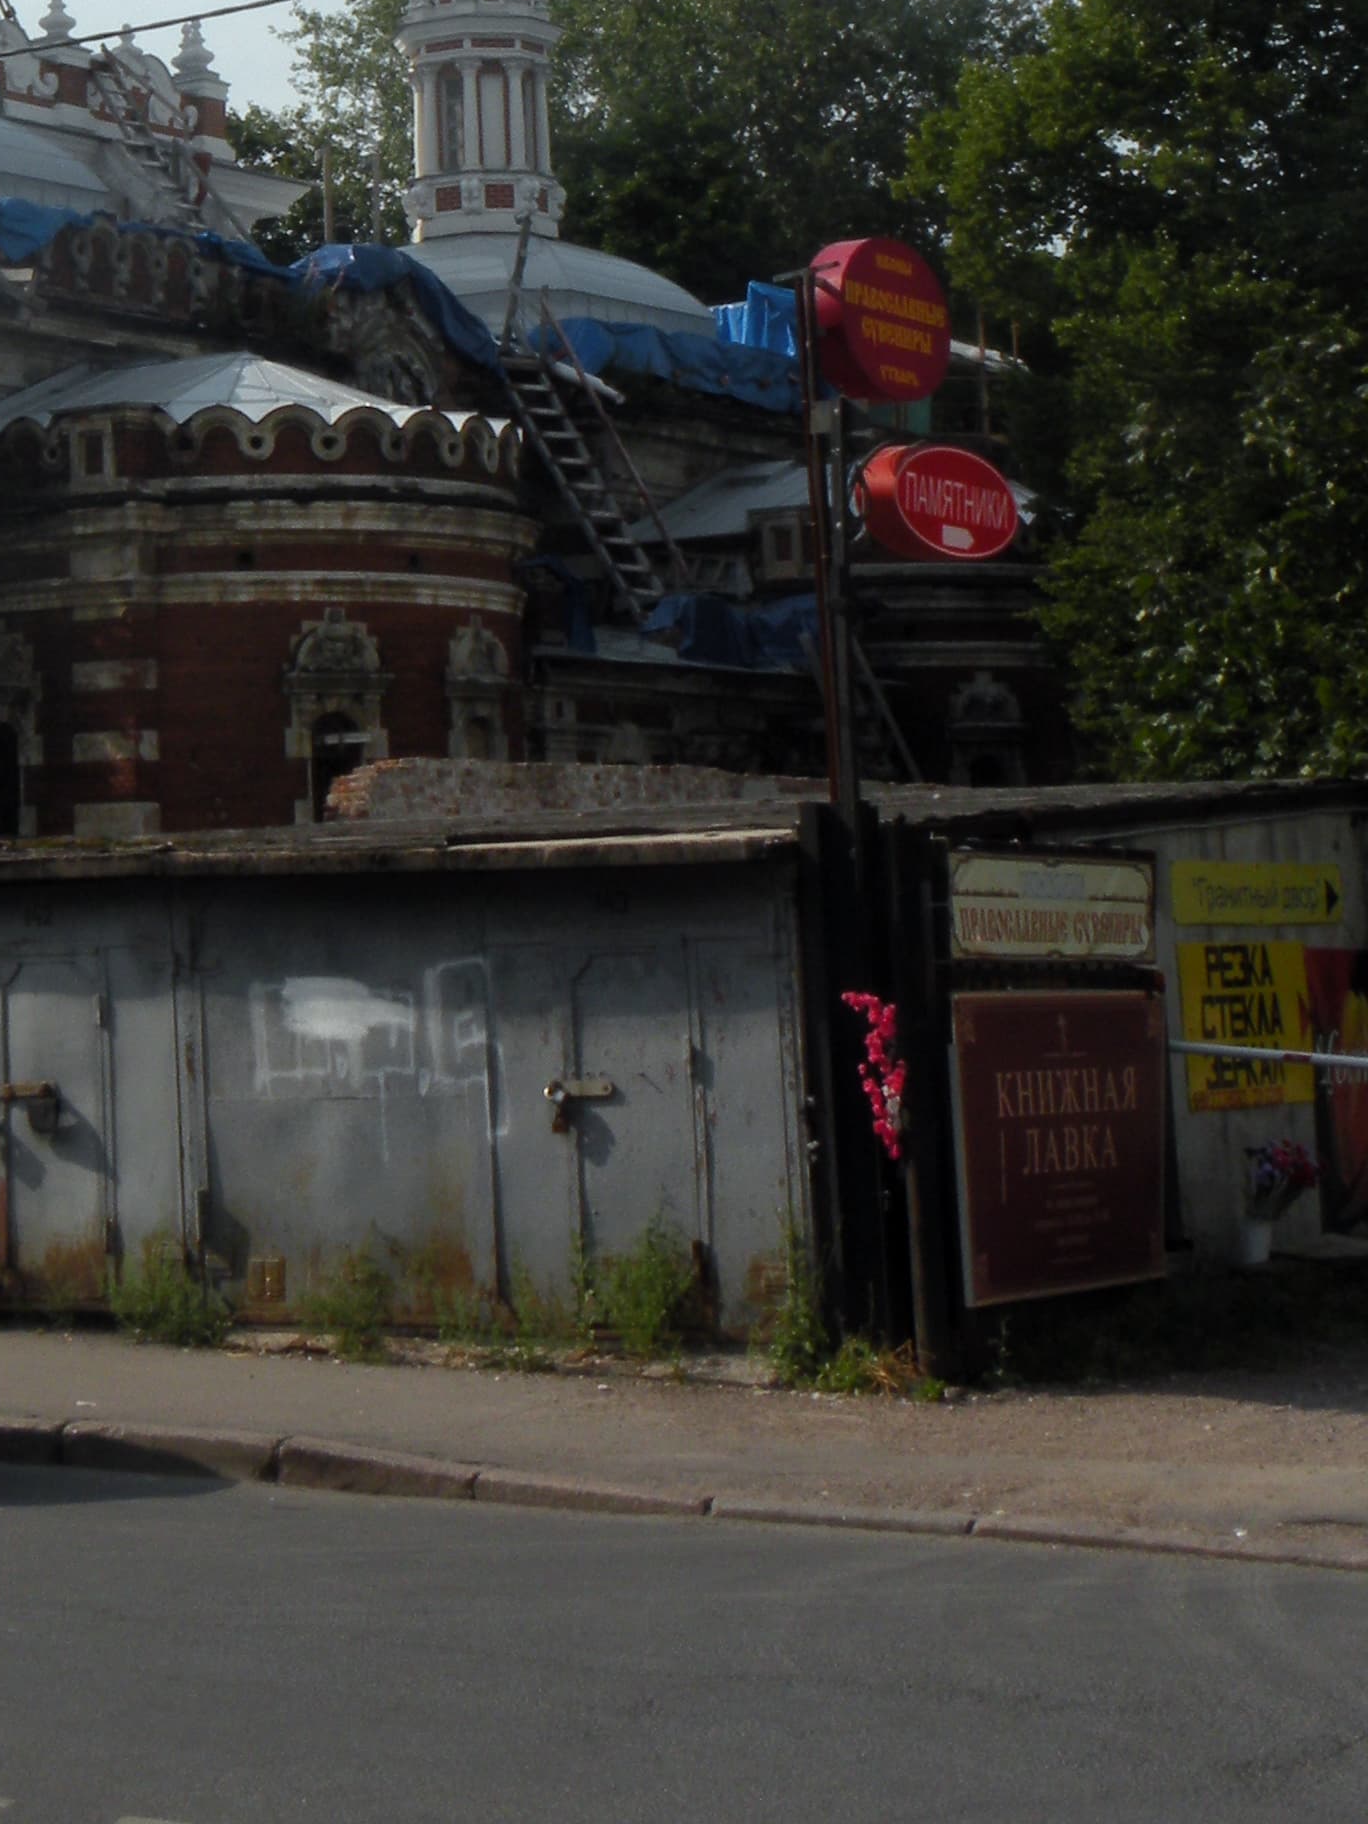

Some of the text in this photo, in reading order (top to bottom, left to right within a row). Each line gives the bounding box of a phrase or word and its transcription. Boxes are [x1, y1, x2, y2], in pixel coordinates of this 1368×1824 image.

[905, 471, 1009, 529] ПАМЯТНИКИ
[1205, 944, 1273, 987] РЕЗКА
[1202, 992, 1283, 1040] СТЕКЛА
[995, 1066, 1138, 1119] КНИЖНАЯ
[1022, 1125, 1119, 1175] ЛАВКА
